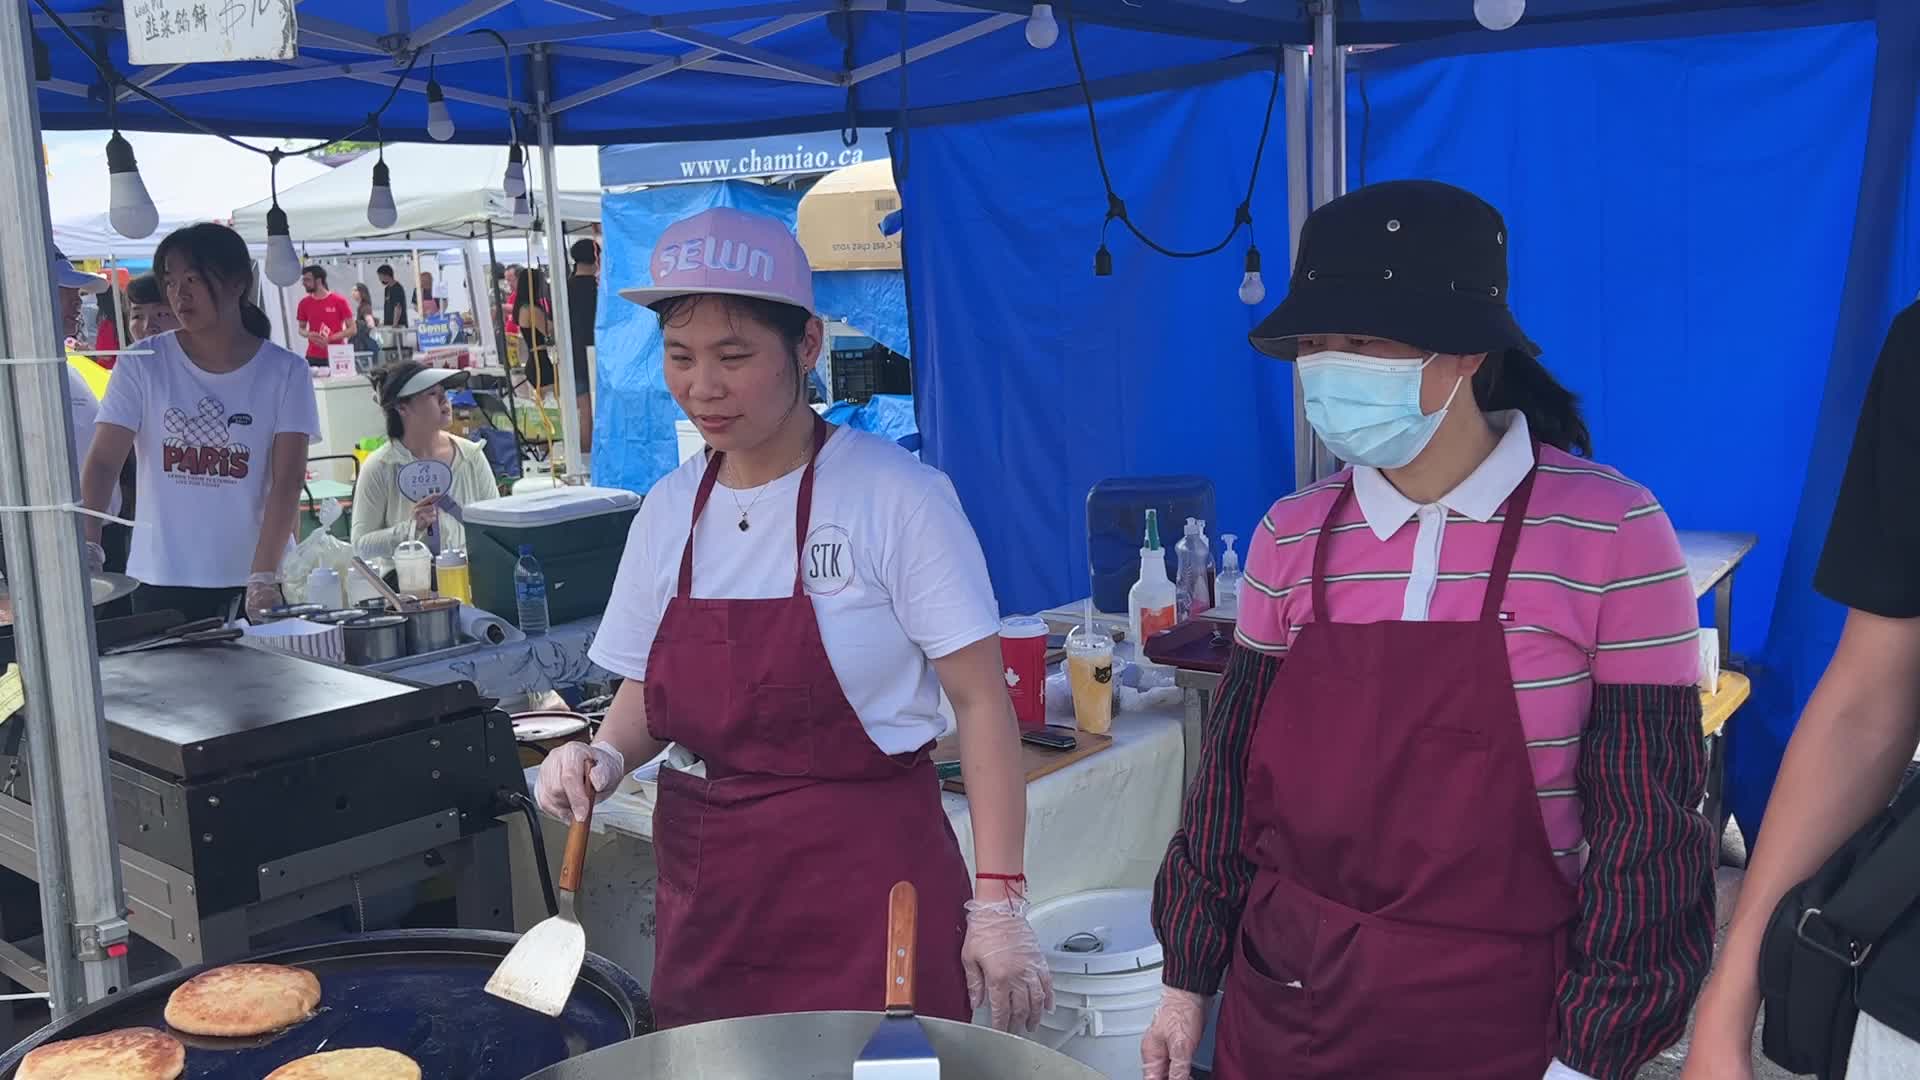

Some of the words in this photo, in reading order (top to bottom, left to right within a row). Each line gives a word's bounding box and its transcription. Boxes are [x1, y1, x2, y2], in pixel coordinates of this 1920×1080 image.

[680, 145, 863, 177] www.chamiao.ca
[412, 474, 438, 483] 2023
[809, 543, 842, 578] STK
